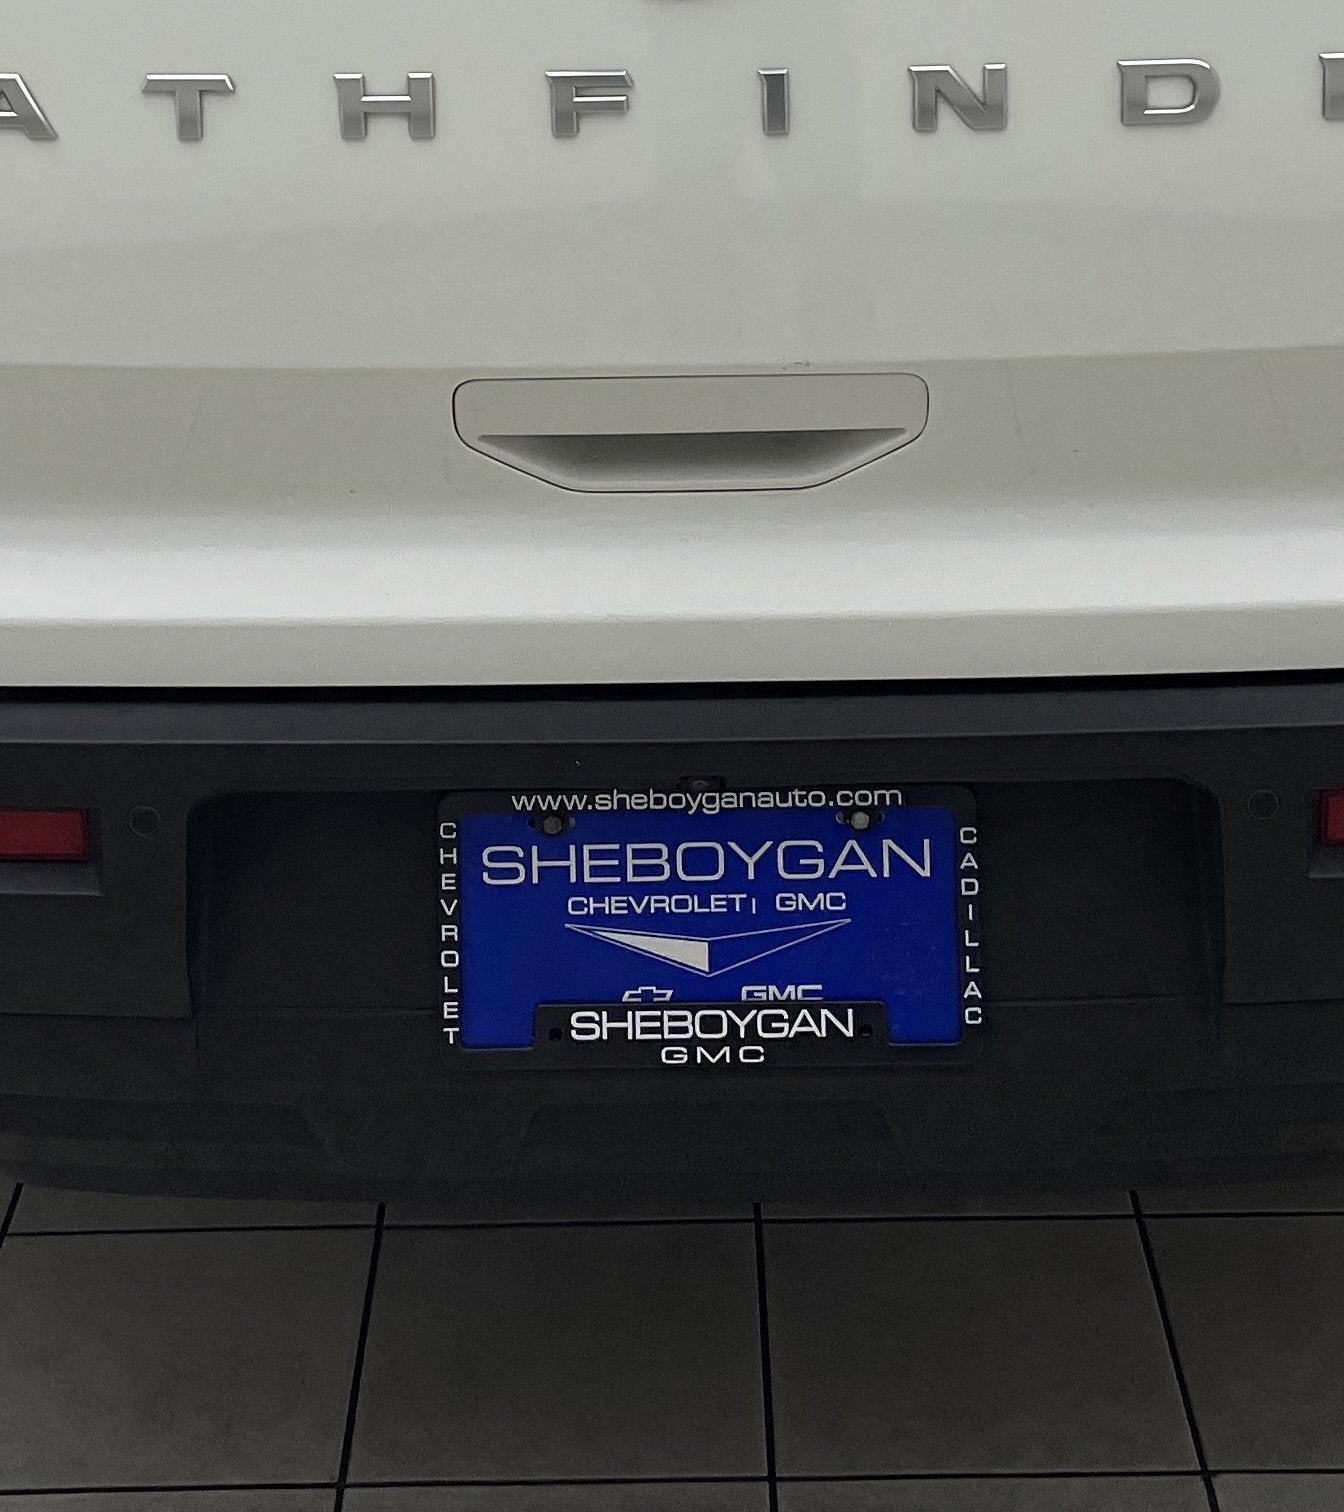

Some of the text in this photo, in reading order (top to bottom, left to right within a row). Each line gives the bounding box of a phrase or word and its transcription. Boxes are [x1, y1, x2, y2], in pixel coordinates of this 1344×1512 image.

[511, 786, 903, 815] www.sheboyganauto.com
[481, 837, 932, 885] SHEBOYGAN
[566, 891, 848, 916] CHEVROLET GMC
[439, 821, 460, 1046] CHEVROLET
[959, 826, 983, 1026] CADILLAC
[740, 984, 825, 1002] GMC
[569, 1007, 855, 1041] SHEBOYGAN
[660, 1045, 766, 1065] GMC
